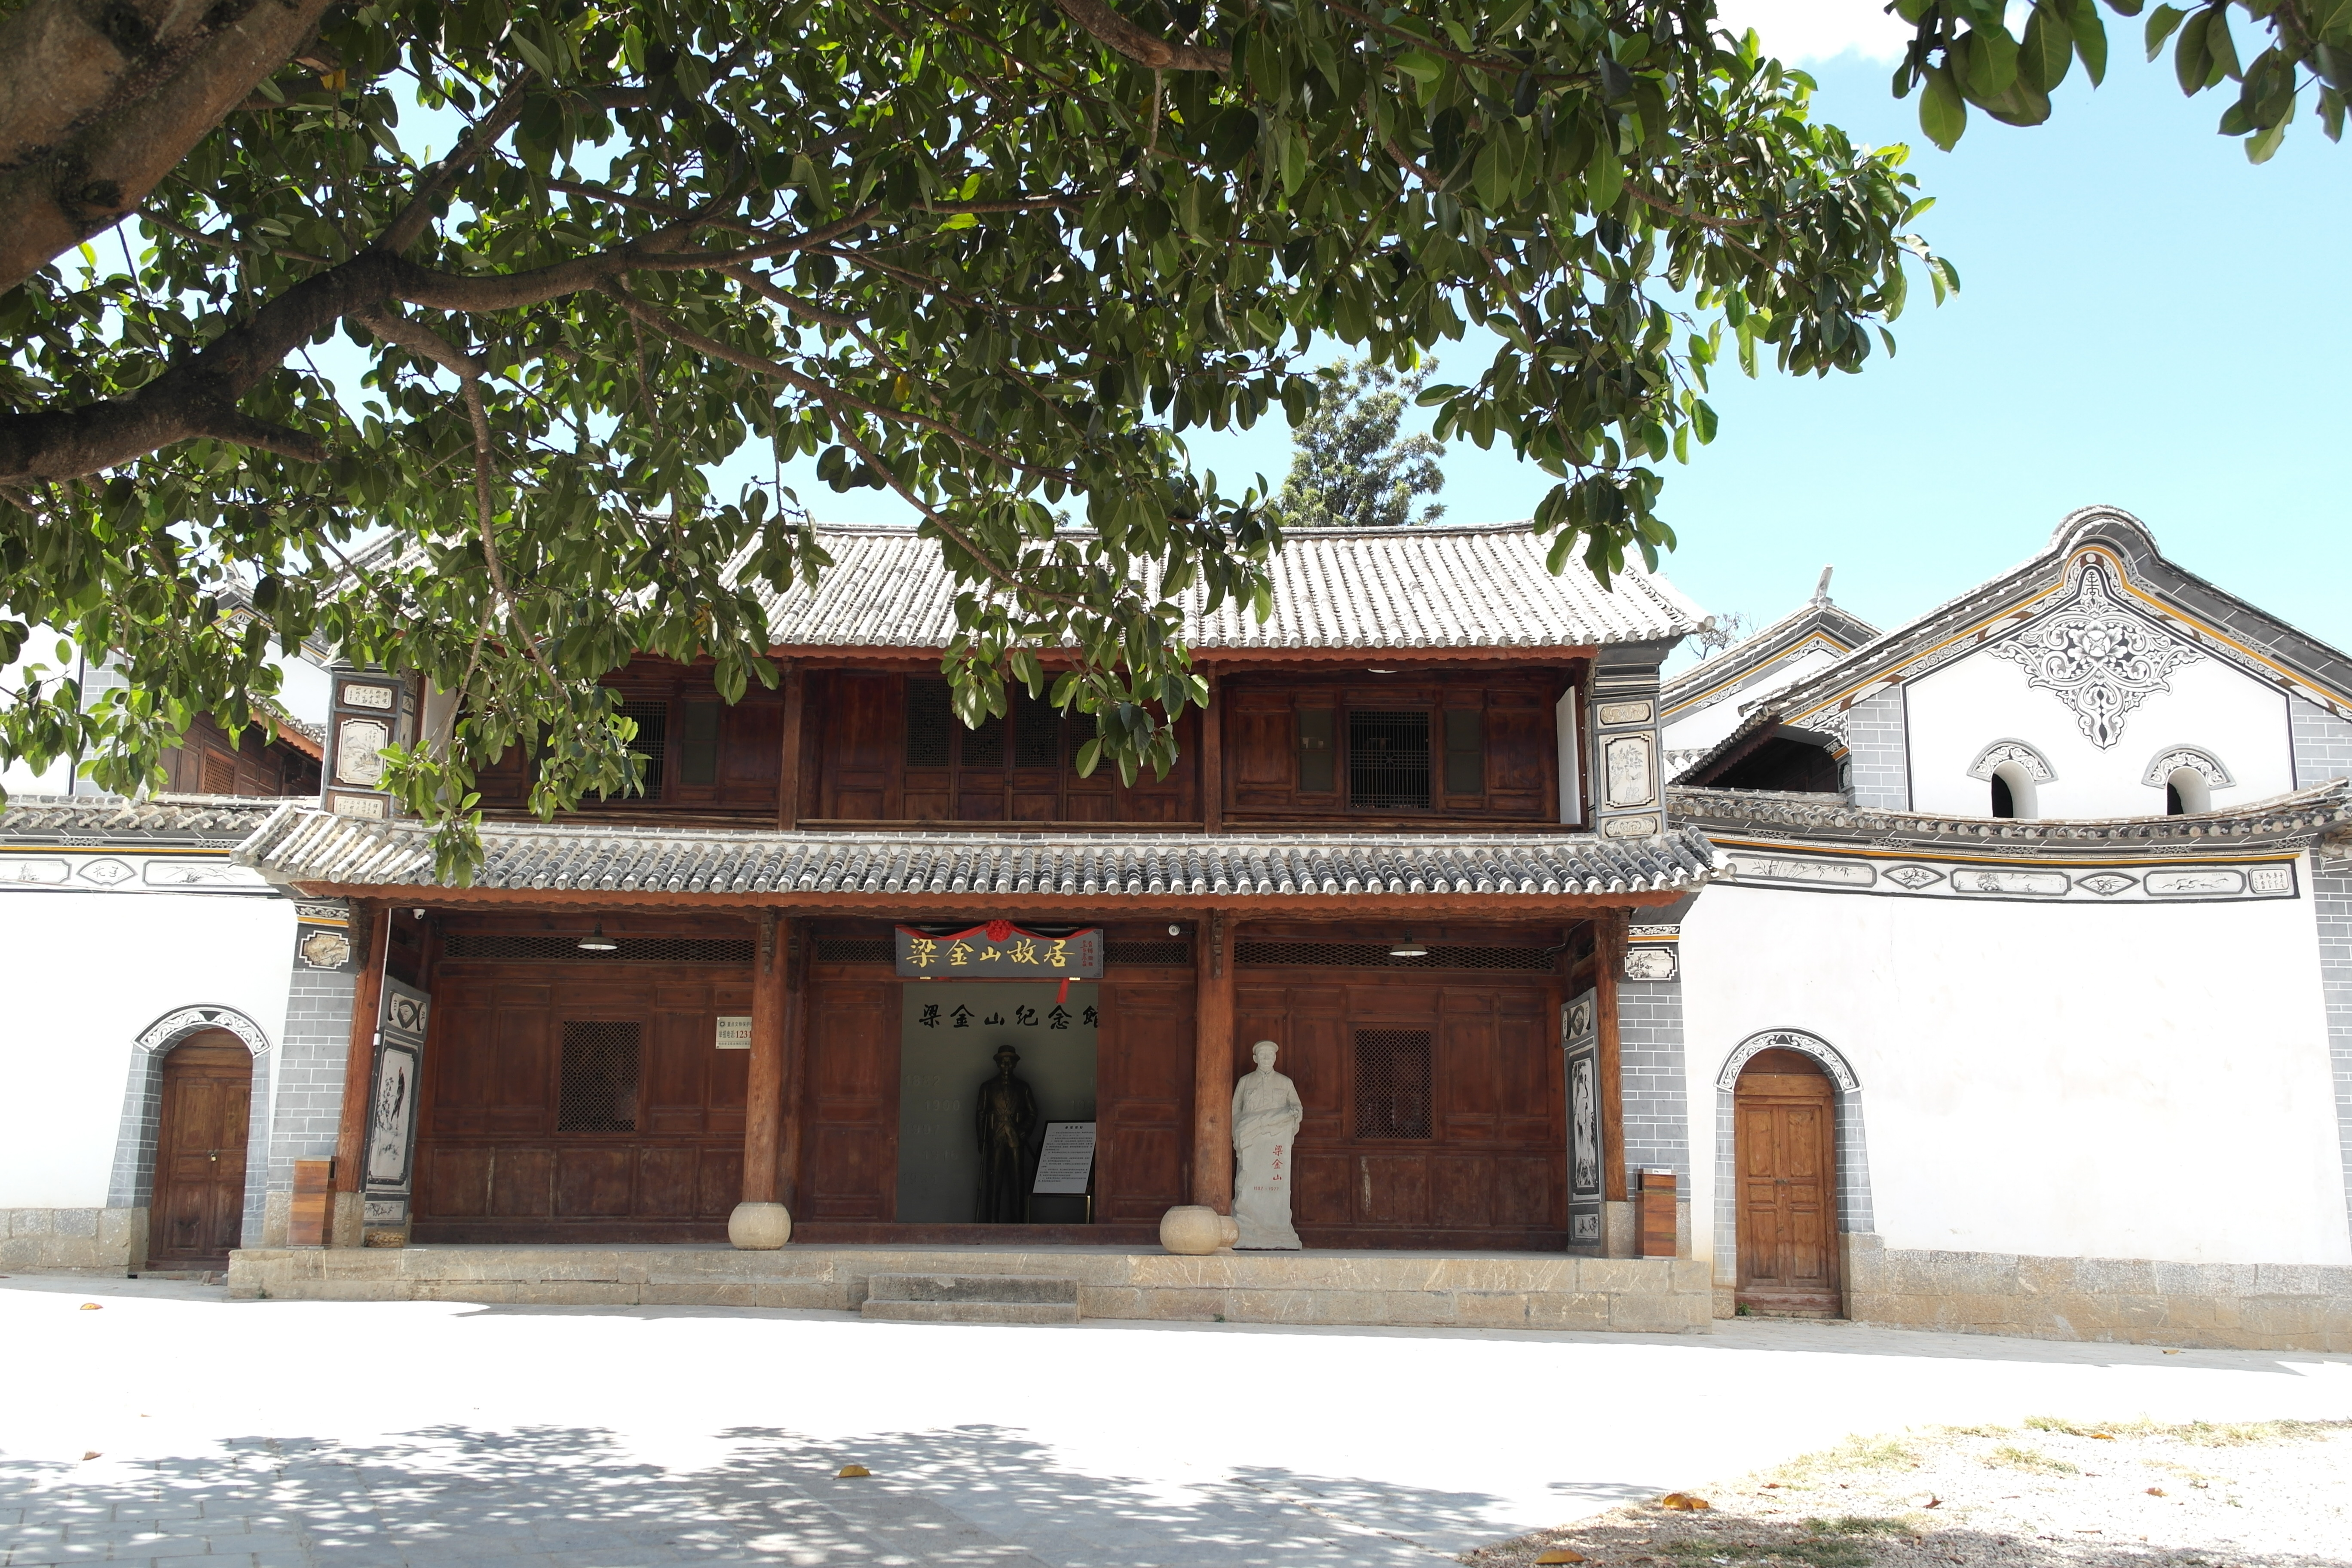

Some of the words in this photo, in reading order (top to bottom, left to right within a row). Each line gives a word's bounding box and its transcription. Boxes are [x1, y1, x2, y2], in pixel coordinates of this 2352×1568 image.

[906, 938, 1075, 968] 梁金山故居
[925, 1099, 960, 1111] 1900
[1272, 1145, 1283, 1180] 梁金山
